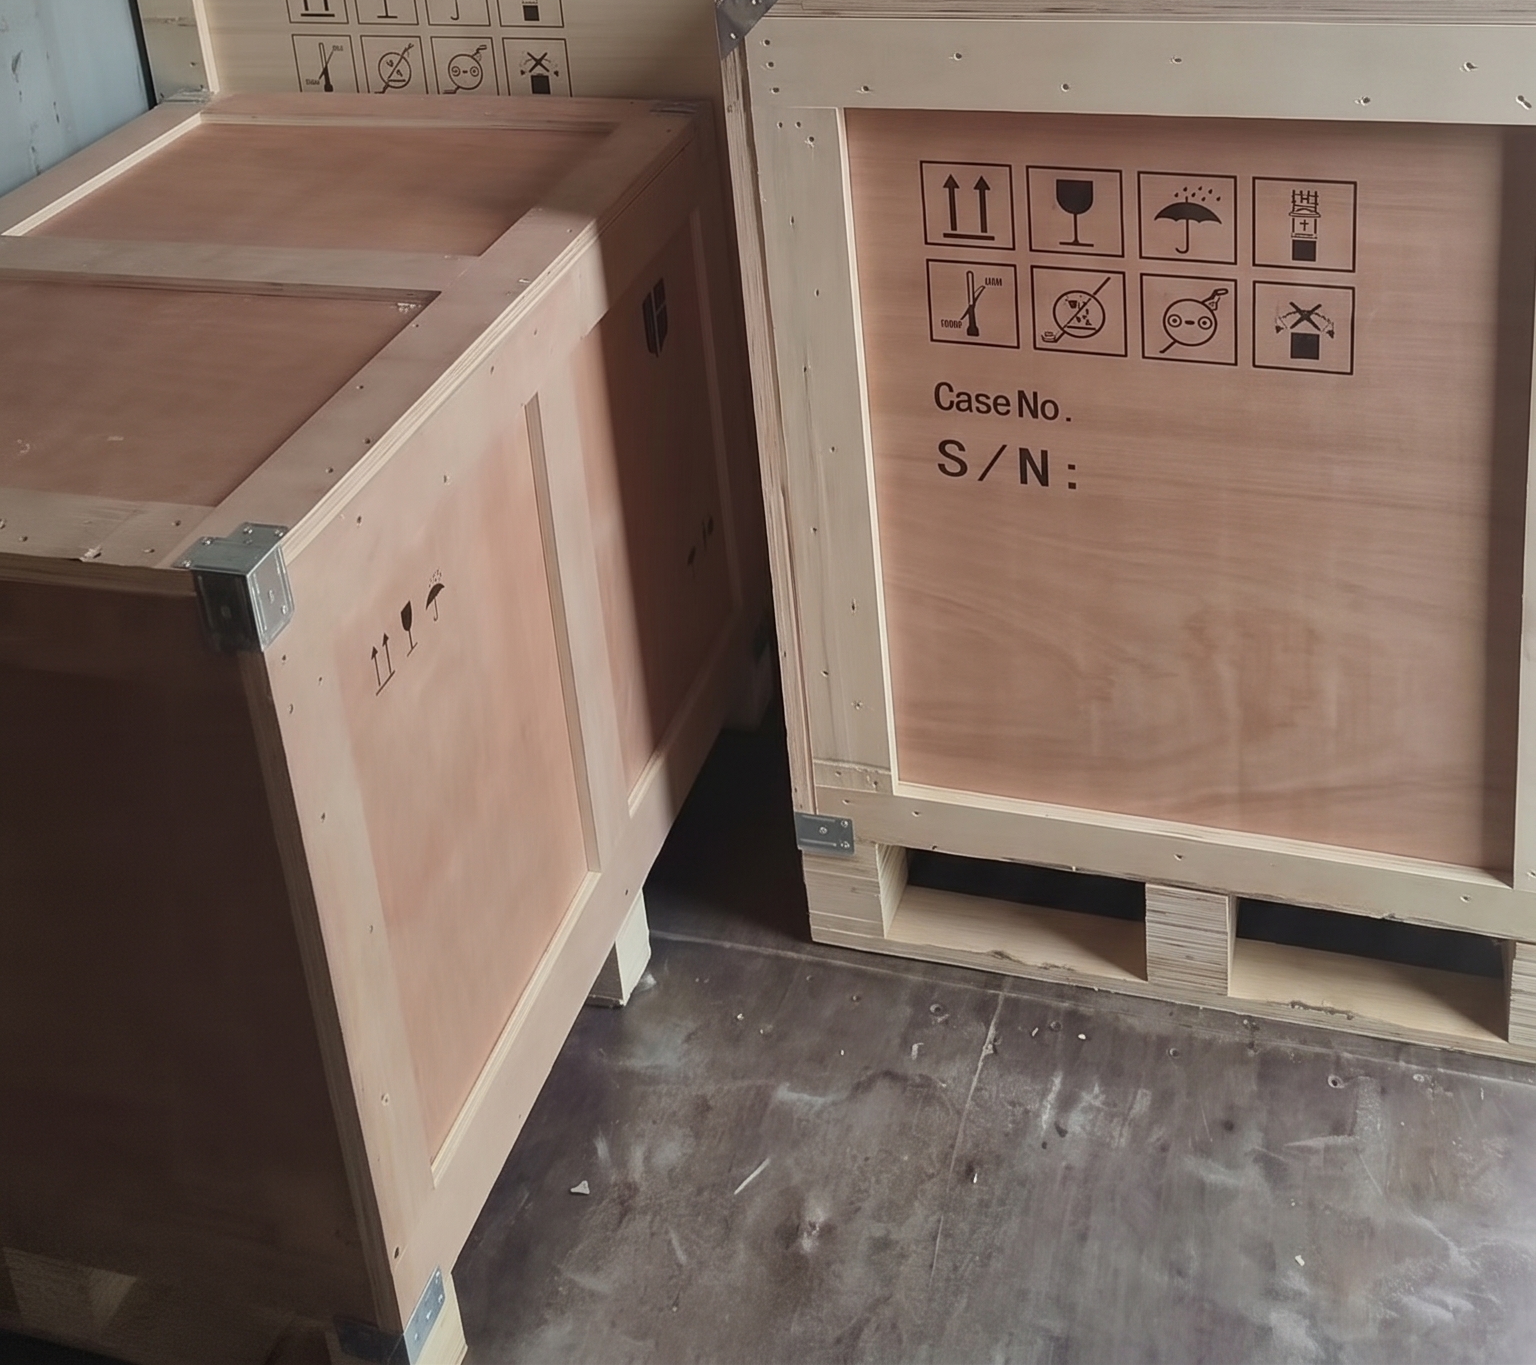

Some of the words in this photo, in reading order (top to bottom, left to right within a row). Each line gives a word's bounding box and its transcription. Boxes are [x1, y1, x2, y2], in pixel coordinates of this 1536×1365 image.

[933, 381, 1012, 416] Case
[1017, 390, 1073, 423] No.
[937, 438, 1077, 490] S/N:
